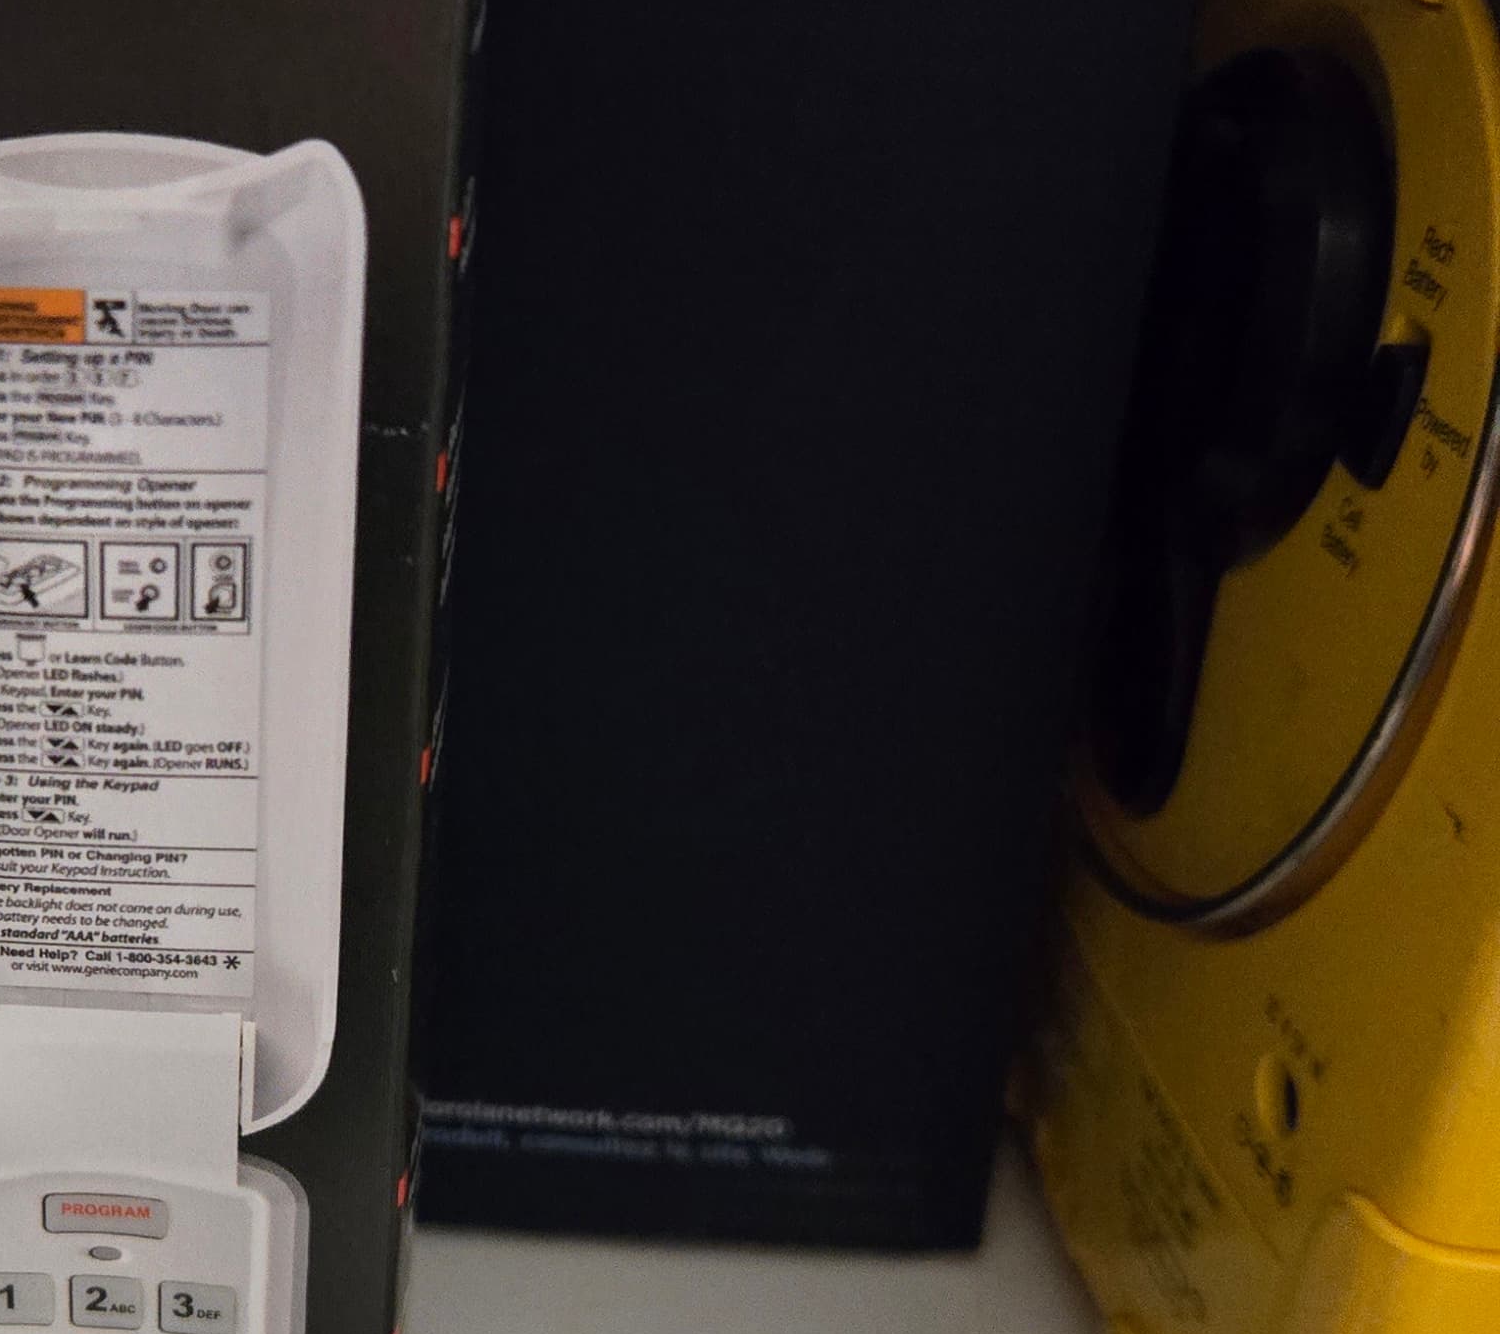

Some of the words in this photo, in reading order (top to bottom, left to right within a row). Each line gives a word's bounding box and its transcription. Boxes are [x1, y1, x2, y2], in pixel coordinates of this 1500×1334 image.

[28, 776, 71, 791] Using
[75, 776, 98, 790] the
[102, 779, 160, 794] Keypad
[41, 848, 64, 859] PIN
[68, 851, 82, 859] or
[86, 850, 152, 864] Changing
[155, 852, 188, 863] PIN?
[20, 863, 49, 875] your
[51, 863, 98, 877] Keypad
[24, 882, 112, 896] Replacement
[6, 897, 62, 912] backlight
[65, 900, 94, 912] does
[97, 902, 117, 913] not
[119, 904, 153, 914] come
[156, 905, 172, 915] on
[174, 904, 215, 917] during
[42, 914, 77, 926] needs
[80, 916, 92, 926] to
[95, 916, 110, 927] be
[113, 917, 169, 930] changed.
[1, 928, 60, 940] standard
[101, 931, 159, 944] batteries
[0, 946, 35, 958] Need
[39, 948, 78, 962] Help?
[85, 950, 112, 961] Call
[116, 951, 218, 966] 1-800-354-3643
[11, 962, 24, 971] or
[26, 961, 49, 972] visit
[51, 964, 199, 979] www.geniecompany.com
[61, 1202, 152, 1220] PROGRAM
[85, 1286, 109, 1313] 2
[109, 1303, 136, 1315] ABC
[172, 1292, 195, 1319] 3
[196, 1309, 222, 1321] DEF
